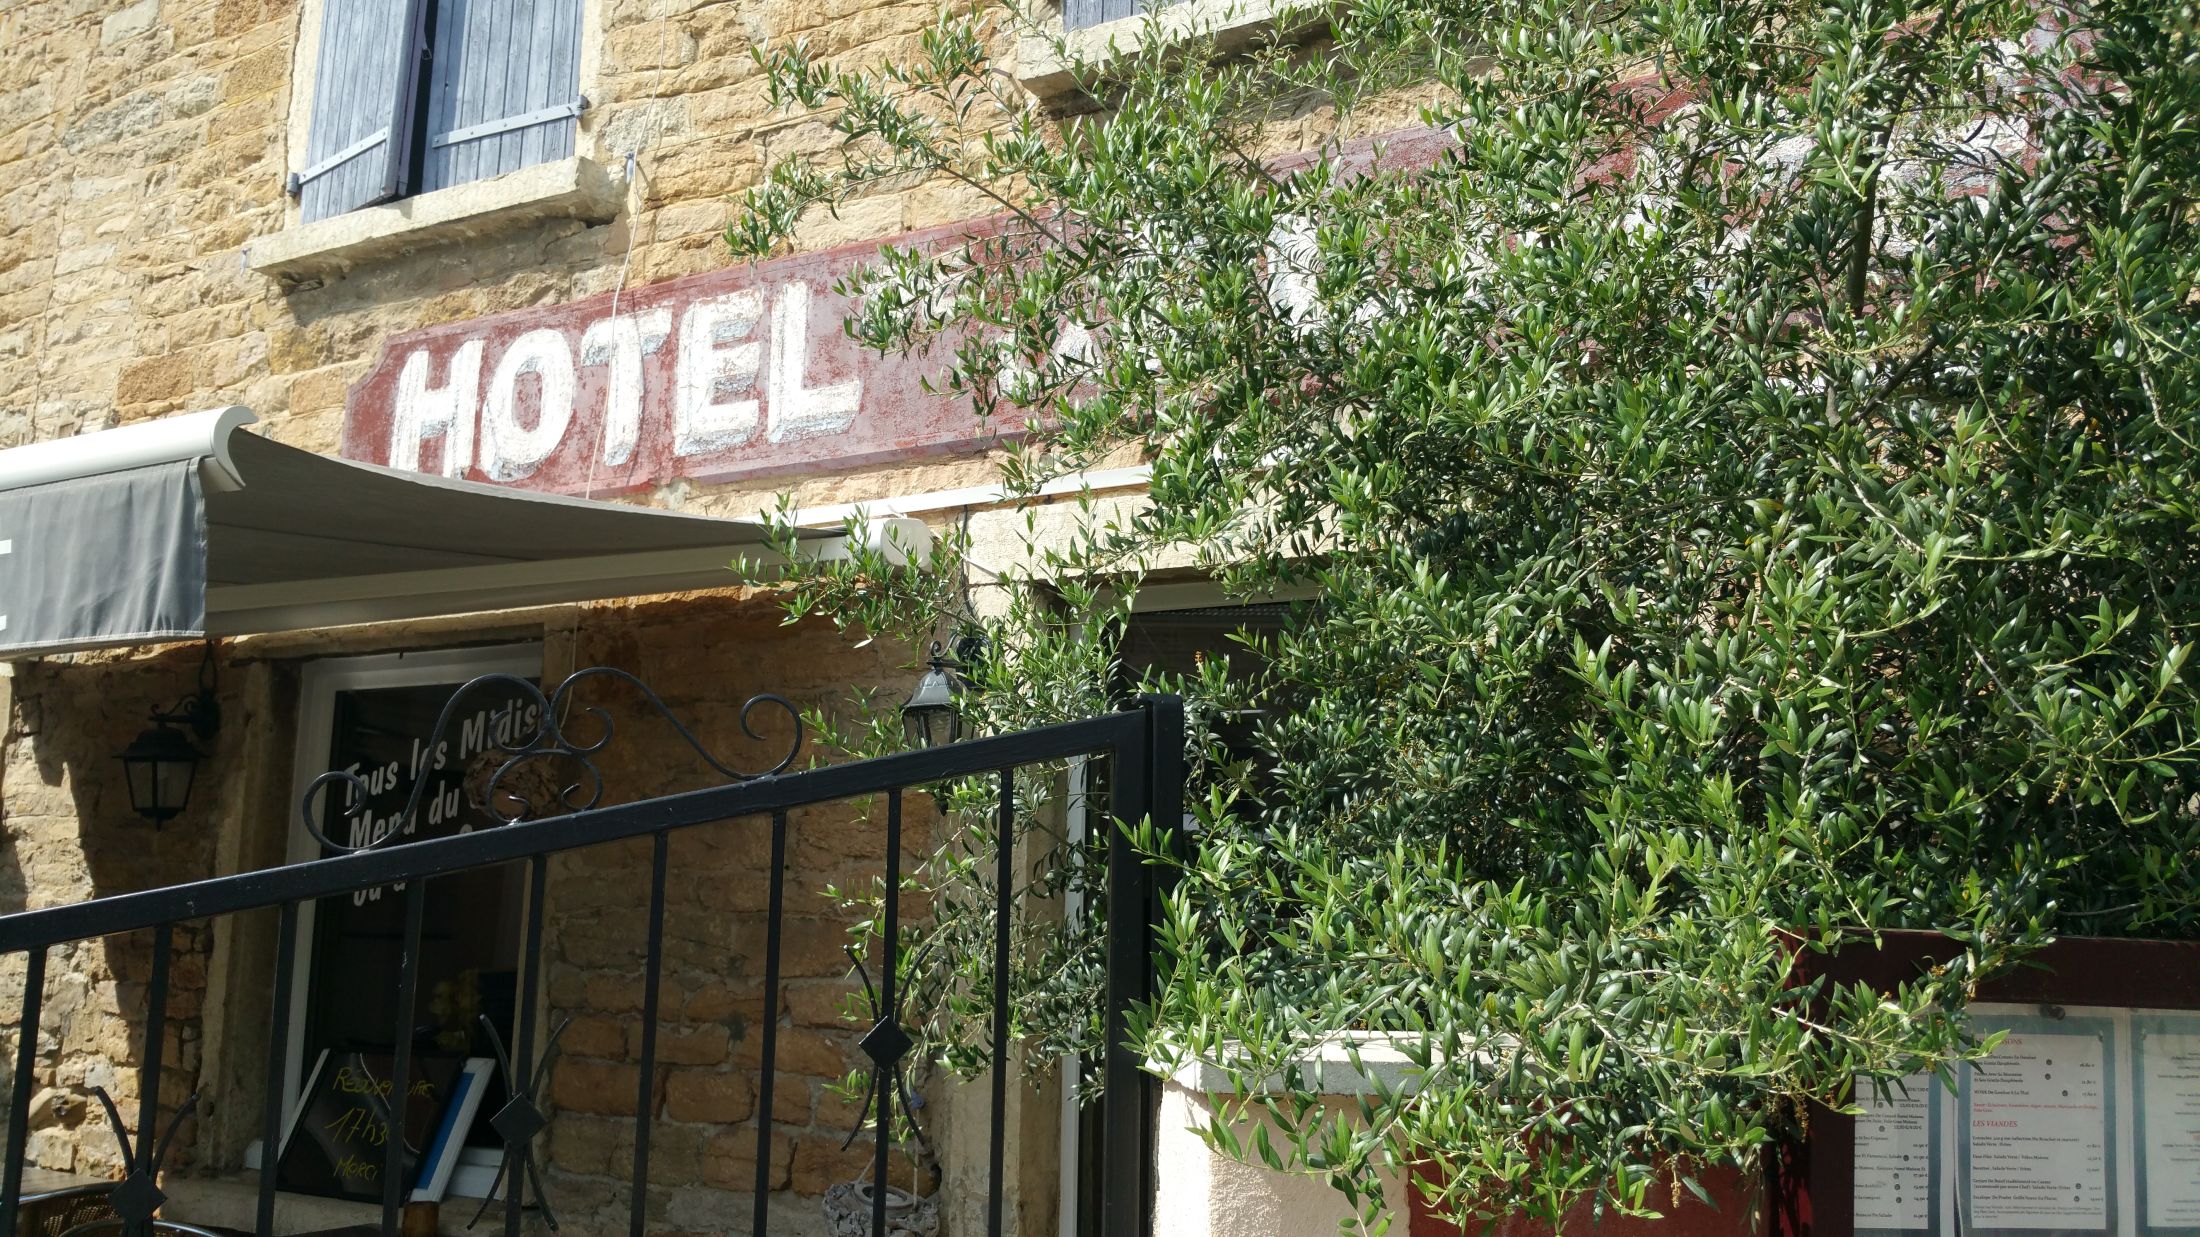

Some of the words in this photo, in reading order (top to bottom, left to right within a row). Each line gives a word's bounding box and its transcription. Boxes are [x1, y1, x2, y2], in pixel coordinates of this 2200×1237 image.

[388, 281, 864, 483] HOTEL
[428, 780, 461, 825] du
[323, 1105, 390, 1147] 17h3
